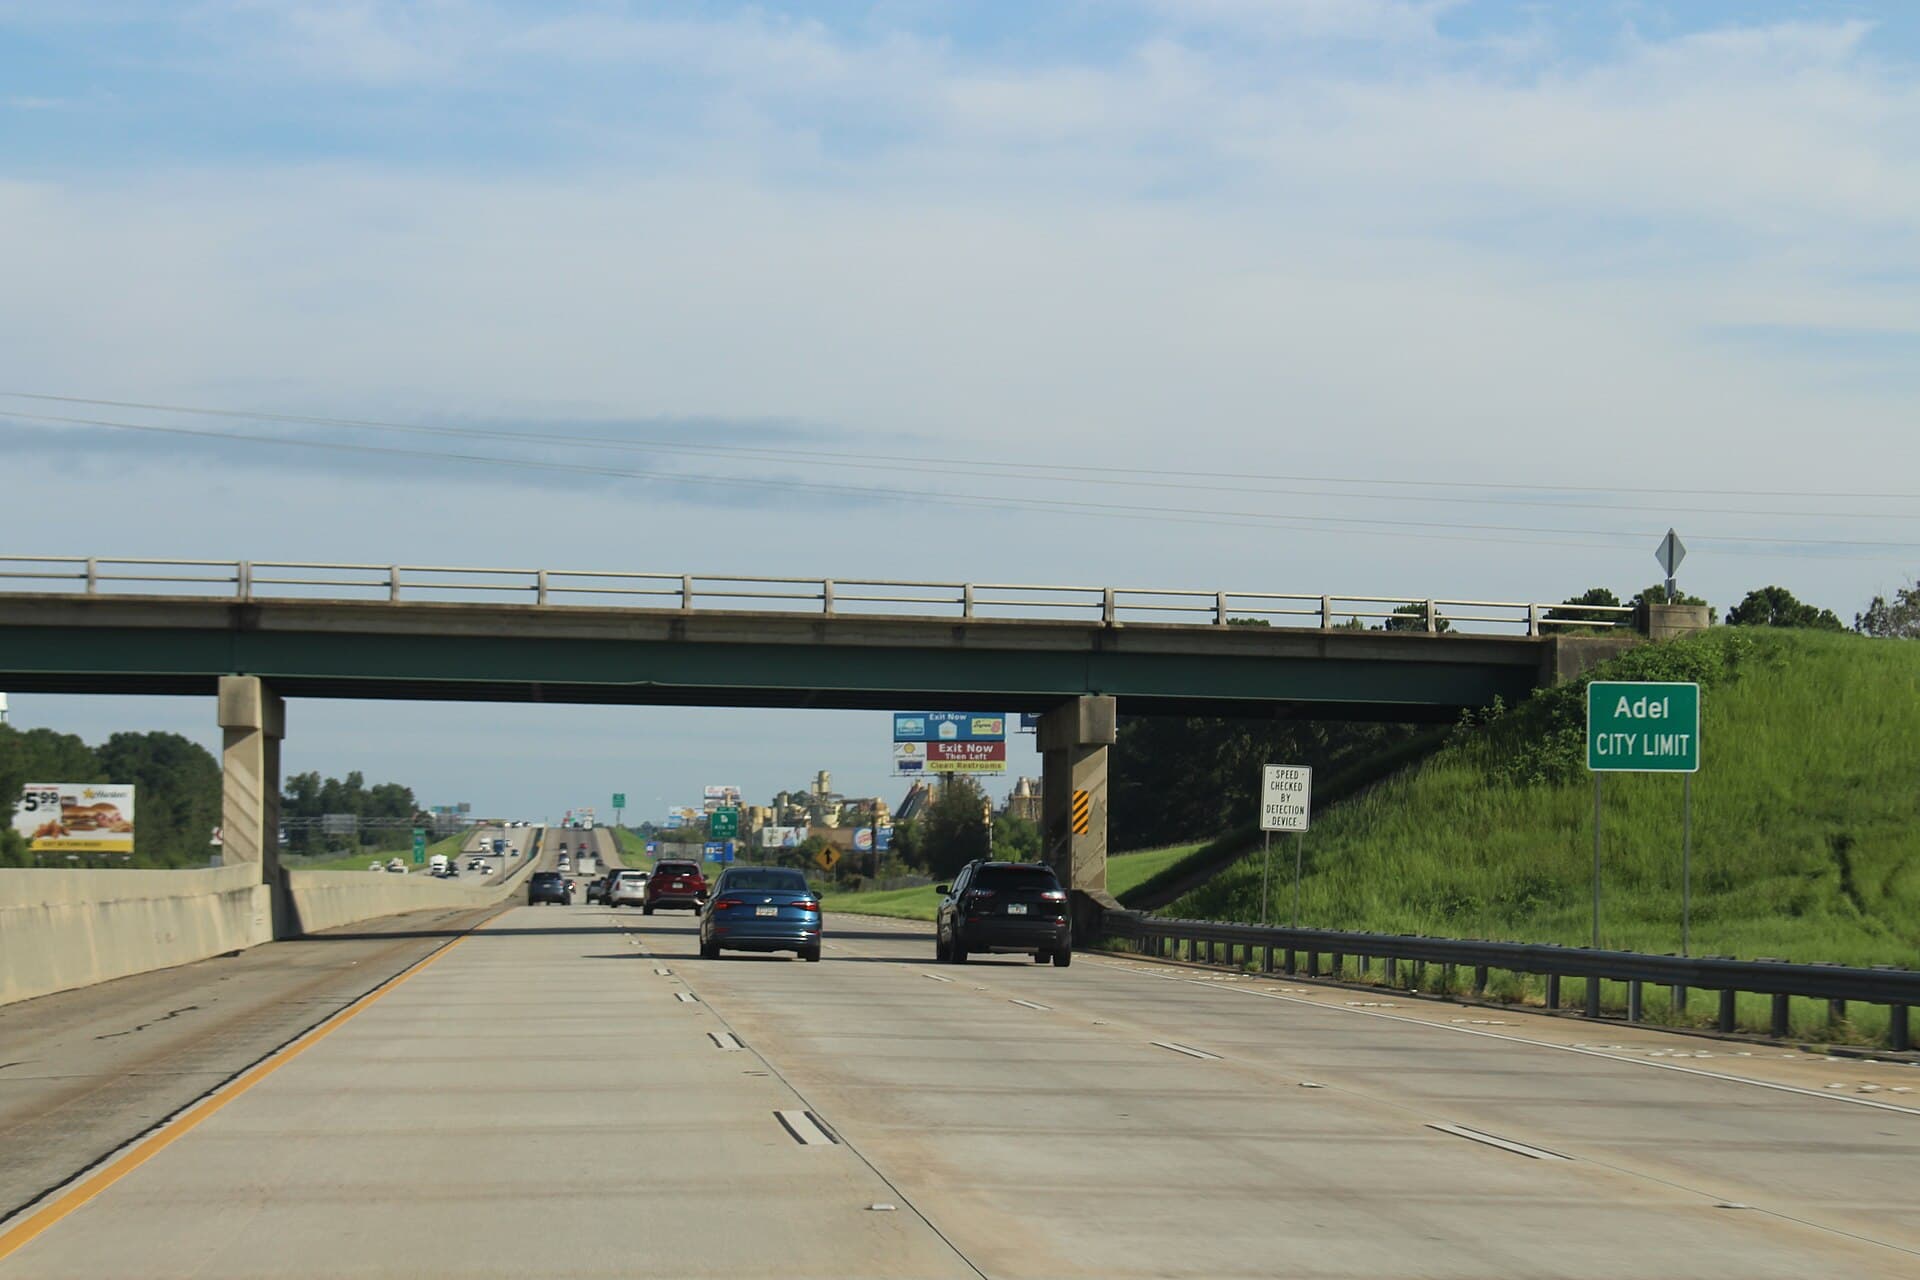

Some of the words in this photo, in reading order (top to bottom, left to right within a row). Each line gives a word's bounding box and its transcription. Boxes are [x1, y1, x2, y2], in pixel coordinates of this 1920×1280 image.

[1614, 696, 1669, 719] Adel
[929, 713, 946, 721] Exit
[948, 713, 967, 721] Now
[939, 744, 962, 753] Exit
[967, 744, 994, 753] Now
[1596, 733, 1637, 755] CITY
[1643, 734, 1690, 756] LIMIT
[1276, 770, 1299, 779] SPEED
[1270, 781, 1303, 791] CHECKED
[1281, 793, 1291, 802] BY
[1266, 804, 1305, 815] DETECTION
[1272, 817, 1297, 826] DEVICE
